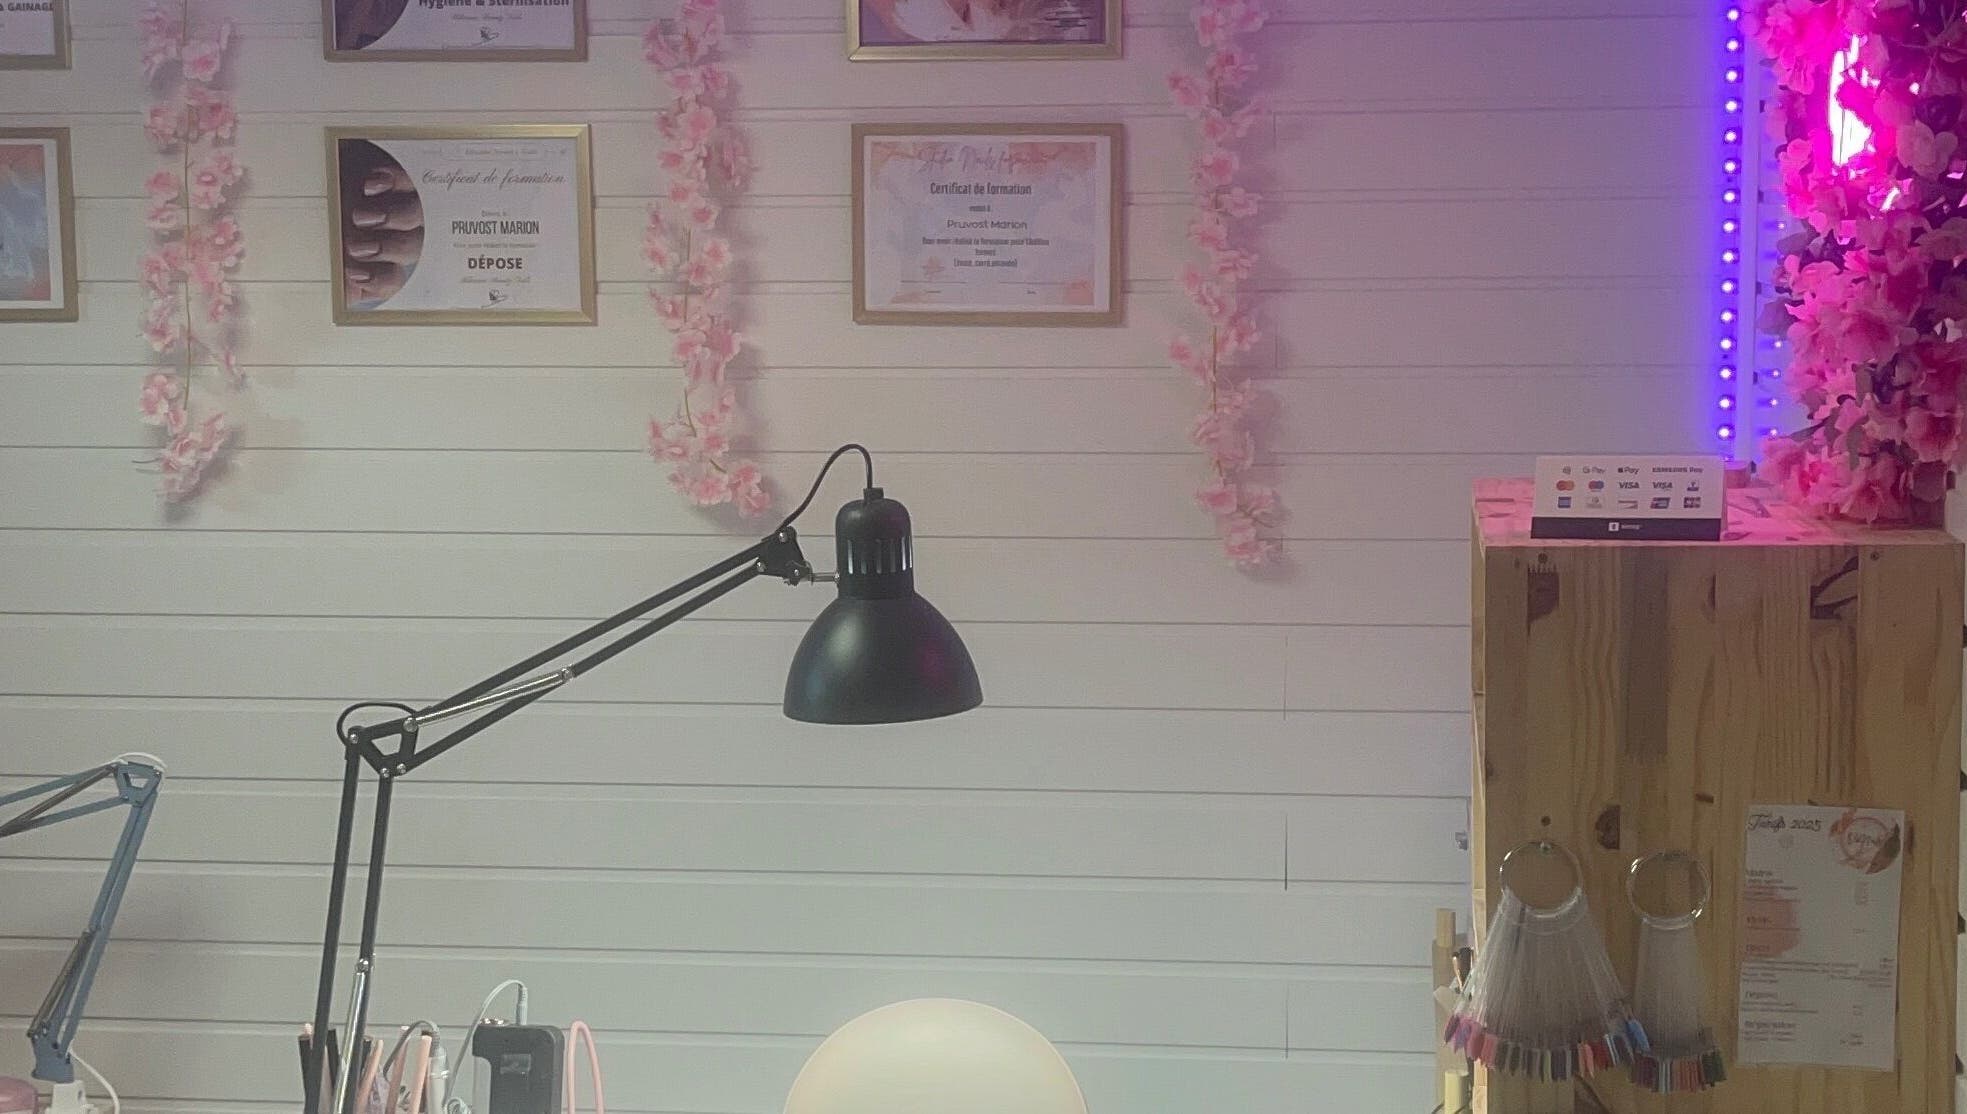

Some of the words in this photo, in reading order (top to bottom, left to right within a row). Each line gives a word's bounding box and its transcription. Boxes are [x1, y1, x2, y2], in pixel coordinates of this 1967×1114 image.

[422, 169, 480, 191] Certificat
[481, 168, 498, 184] de
[498, 168, 566, 191] formation
[930, 182, 972, 195] Certificat
[973, 182, 985, 195] de
[987, 182, 1032, 196] formation
[451, 221, 498, 235] PRUVOST
[500, 221, 540, 235] MARION
[946, 219, 988, 229] Pruvost
[990, 220, 1028, 230] Marion
[467, 254, 523, 270] DÉPOSE
[1624, 466, 1640, 475] Pay
[1790, 818, 1823, 833] 2025
